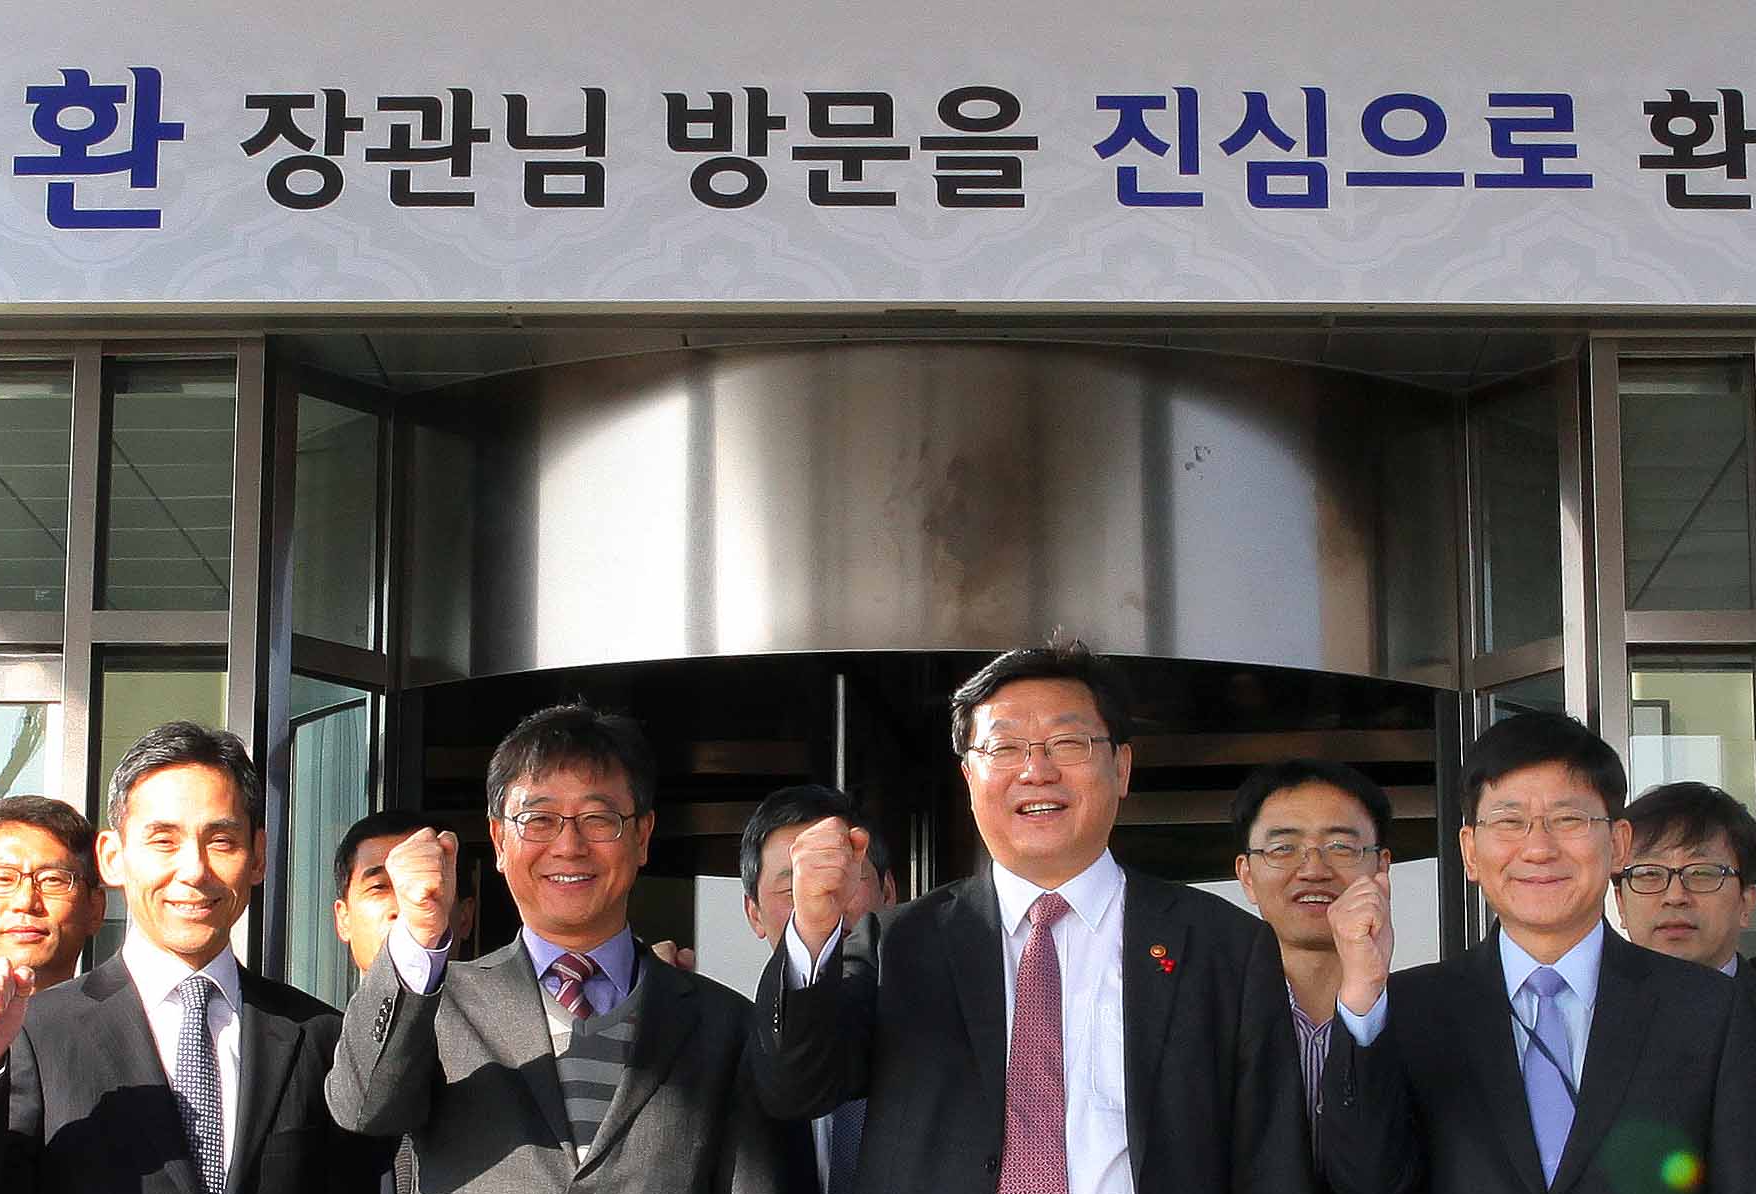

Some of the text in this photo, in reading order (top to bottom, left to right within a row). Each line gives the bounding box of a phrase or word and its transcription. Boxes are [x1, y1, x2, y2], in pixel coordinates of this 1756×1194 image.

[239, 86, 608, 211] 장관님
[662, 85, 1040, 211] 방문을
[1091, 85, 1594, 211] 진심으로
